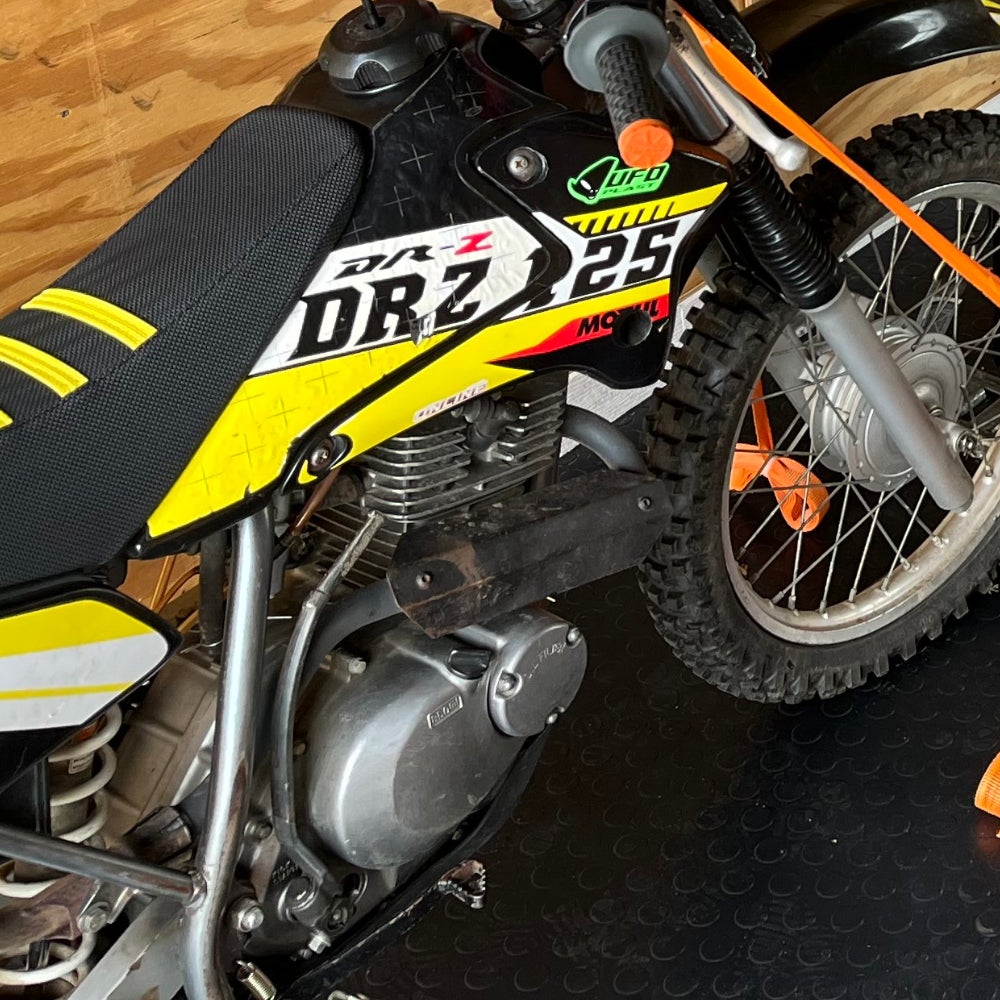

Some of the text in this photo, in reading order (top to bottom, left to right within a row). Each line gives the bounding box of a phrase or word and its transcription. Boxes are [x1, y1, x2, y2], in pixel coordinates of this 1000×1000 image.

[605, 165, 667, 188] UFO
[288, 257, 492, 361] DRZ
[576, 299, 660, 337] MOUL
